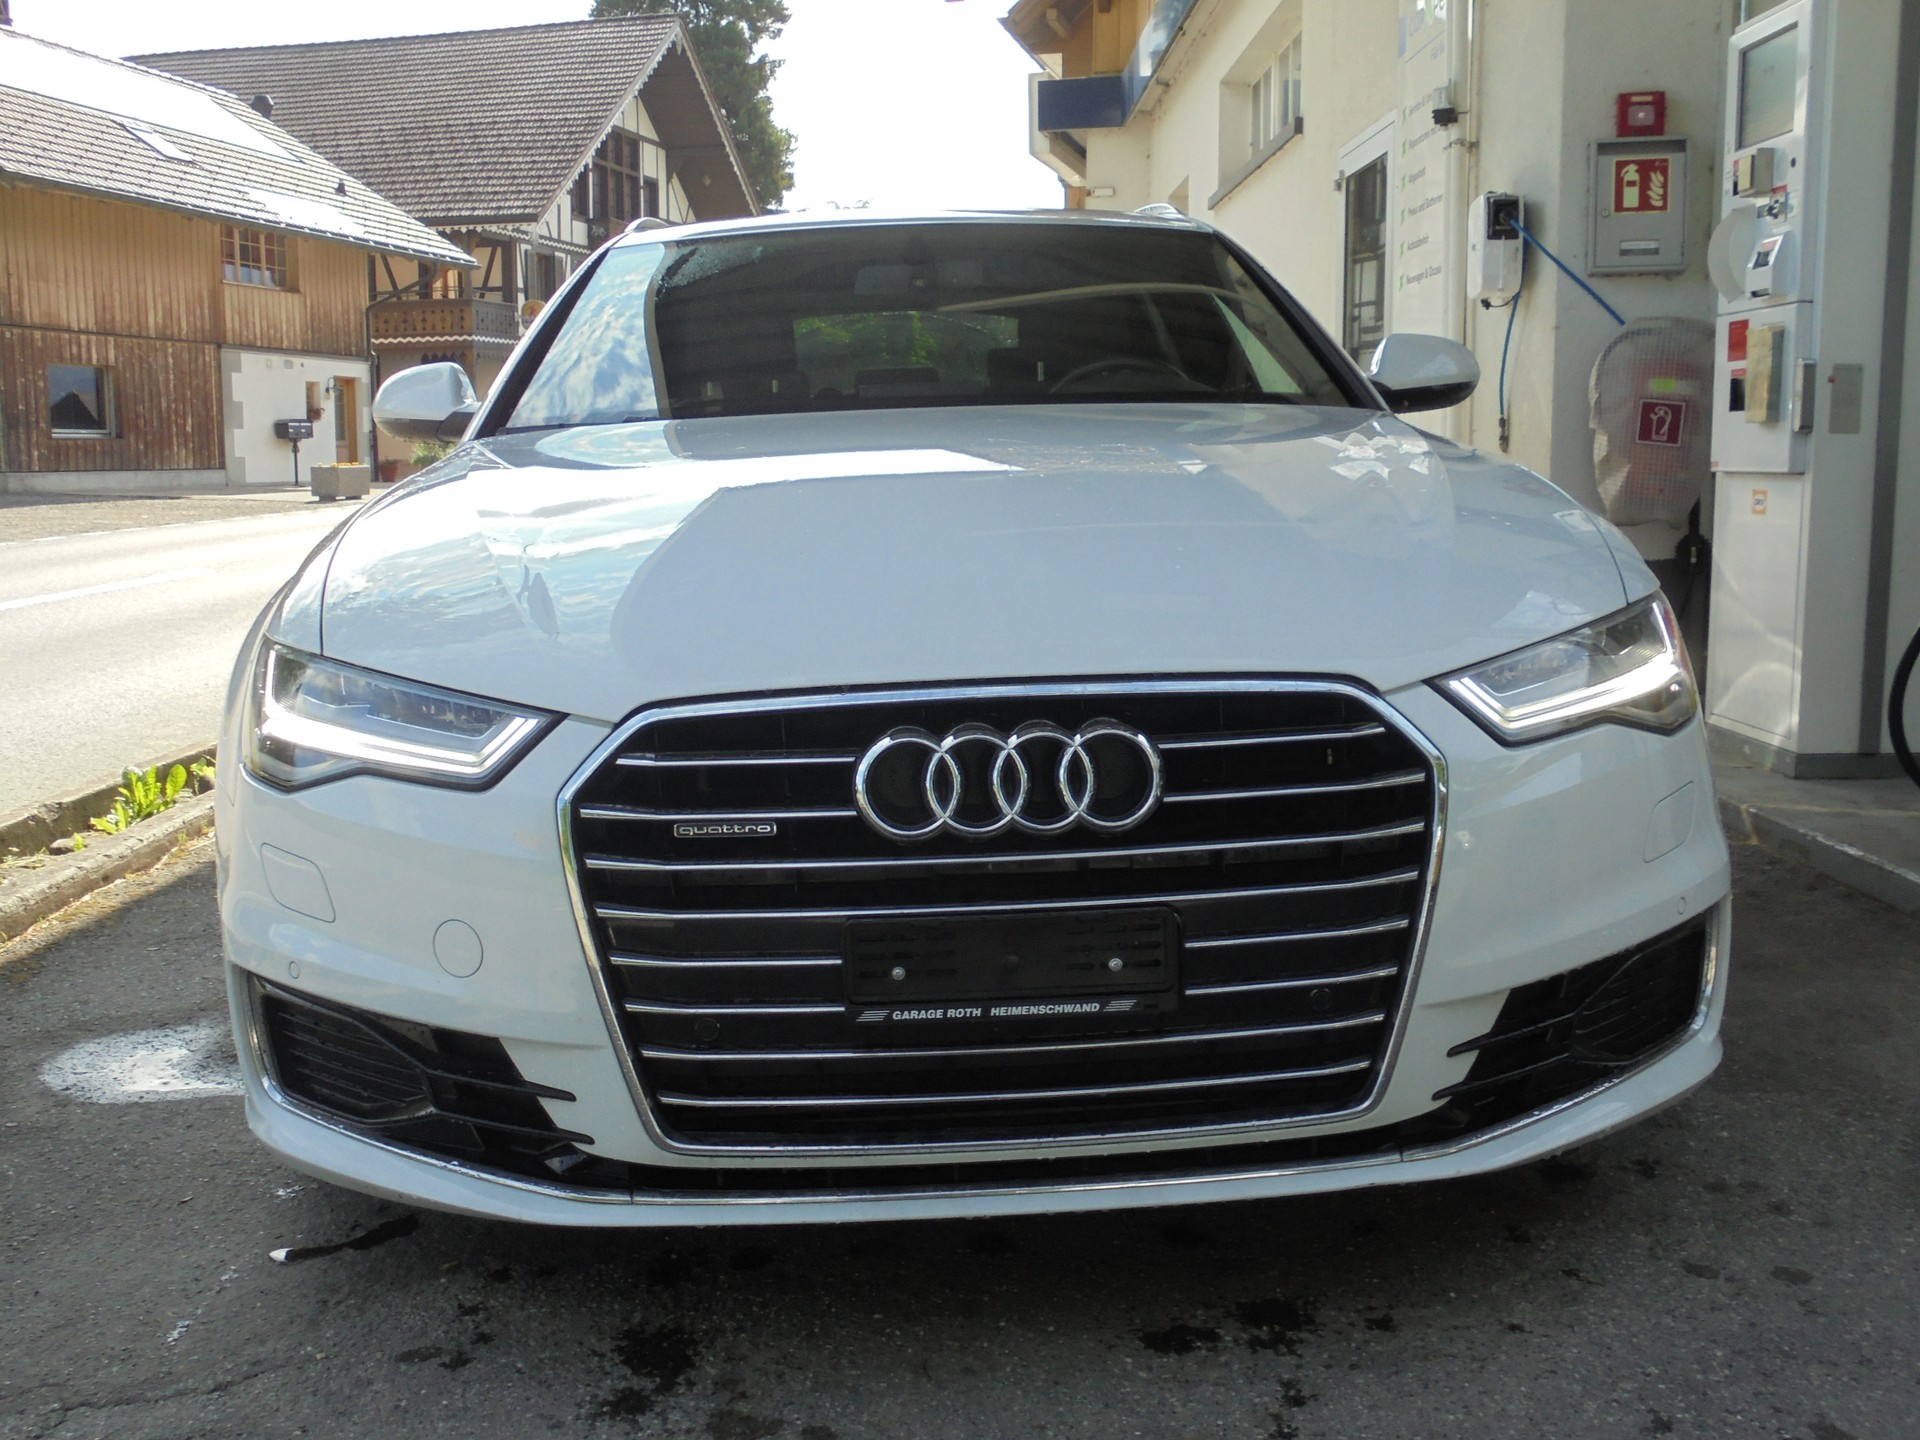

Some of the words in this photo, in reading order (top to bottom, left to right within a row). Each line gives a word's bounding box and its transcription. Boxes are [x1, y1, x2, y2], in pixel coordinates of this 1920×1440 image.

[679, 824, 771, 835] quattro
[892, 1009, 944, 1020] GARAGE
[947, 1007, 982, 1018] ROTH
[990, 1002, 1100, 1017] HEIMENSCHWAND
